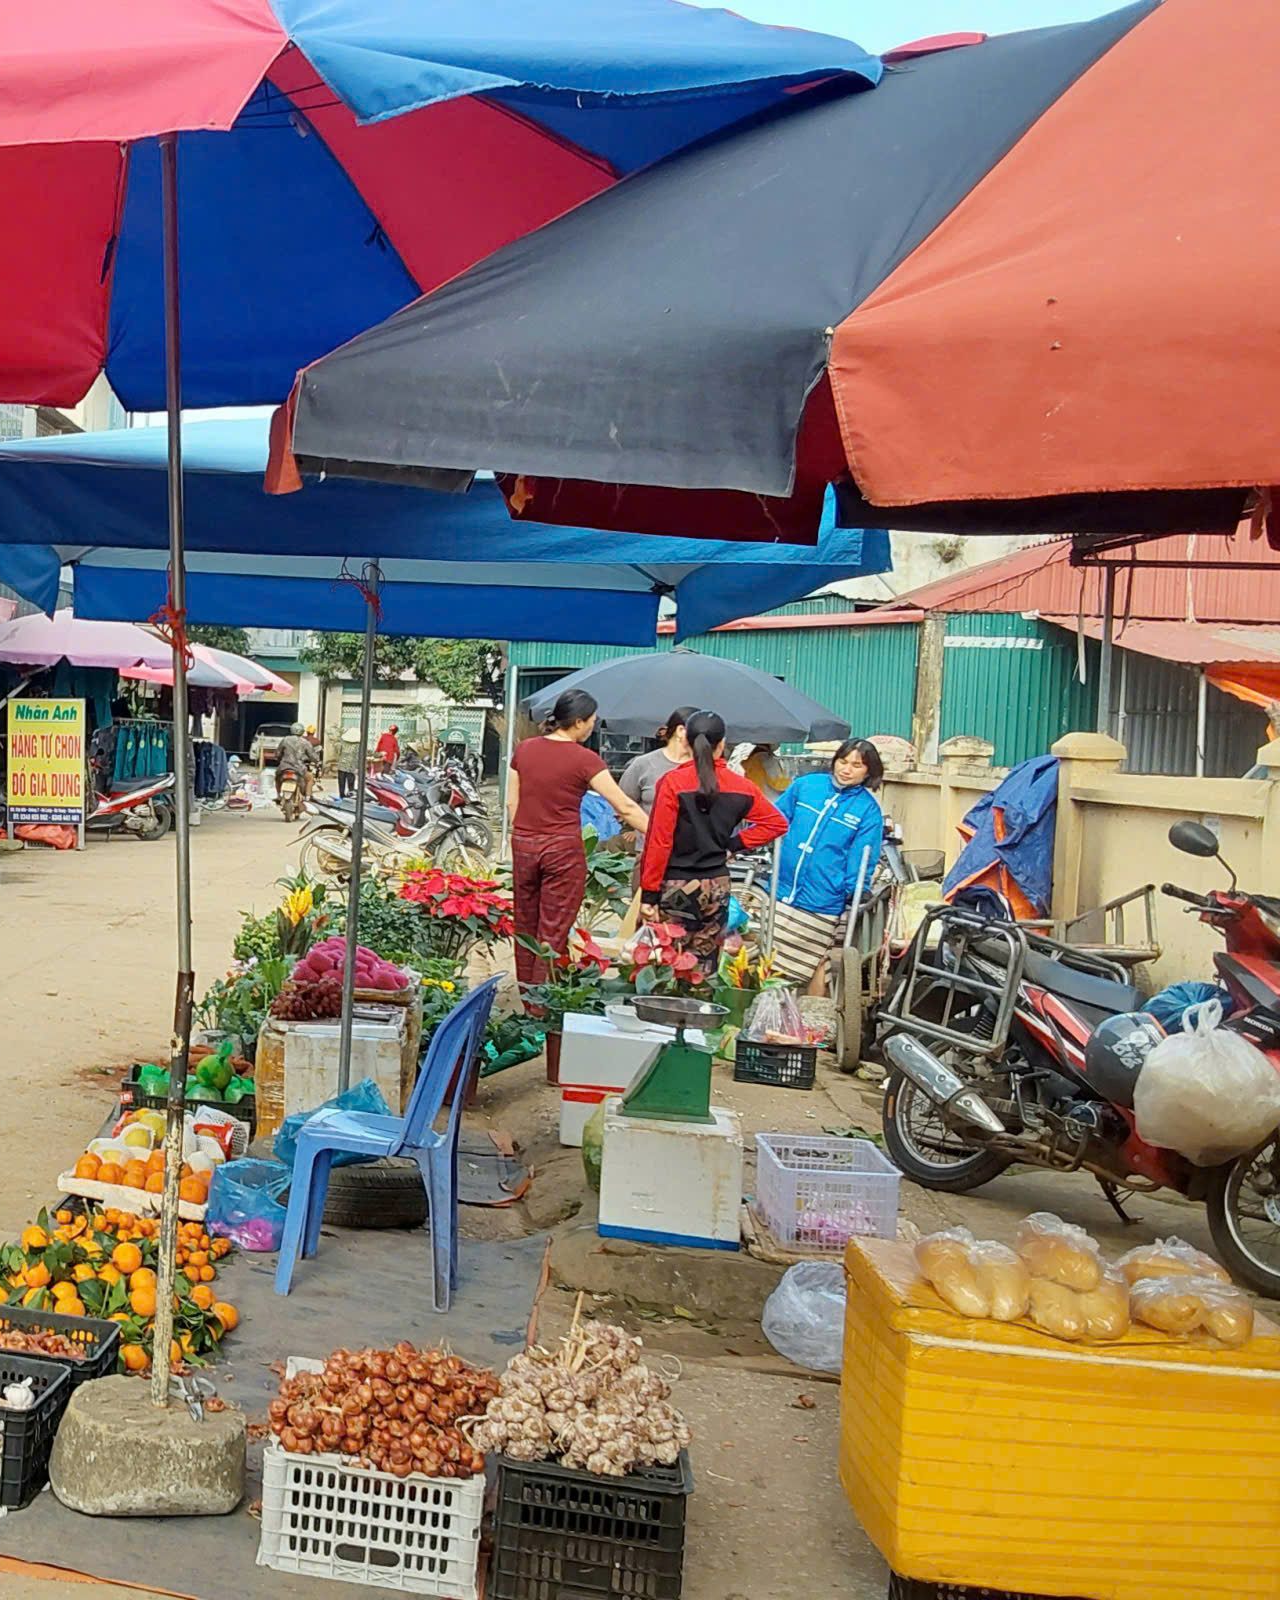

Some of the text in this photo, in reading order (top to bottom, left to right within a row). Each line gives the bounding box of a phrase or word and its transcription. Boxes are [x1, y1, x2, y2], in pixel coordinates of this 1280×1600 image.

[15, 705, 77, 720] Nhân Anh
[11, 728, 37, 758] HÀNG
[40, 732, 53, 764] TỰ
[30, 772, 48, 797] GIA
[51, 773, 81, 802] DỤNG
